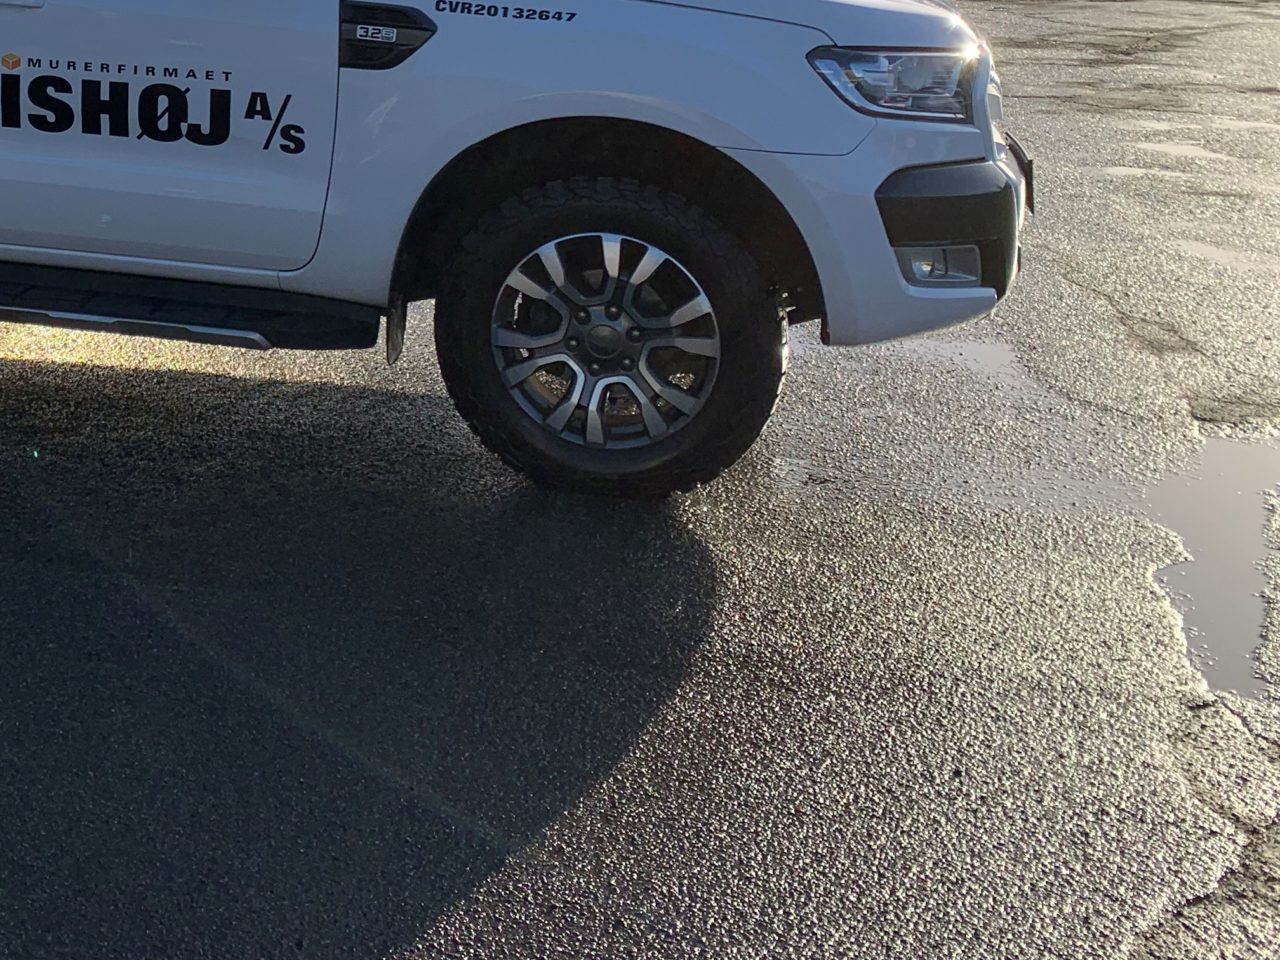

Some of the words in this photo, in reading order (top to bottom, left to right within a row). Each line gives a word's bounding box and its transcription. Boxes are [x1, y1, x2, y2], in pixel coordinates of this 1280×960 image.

[435, 0, 577, 22] CVR20132647
[28, 58, 232, 82] MURERFIRMAET
[244, 92, 305, 154] A/S
